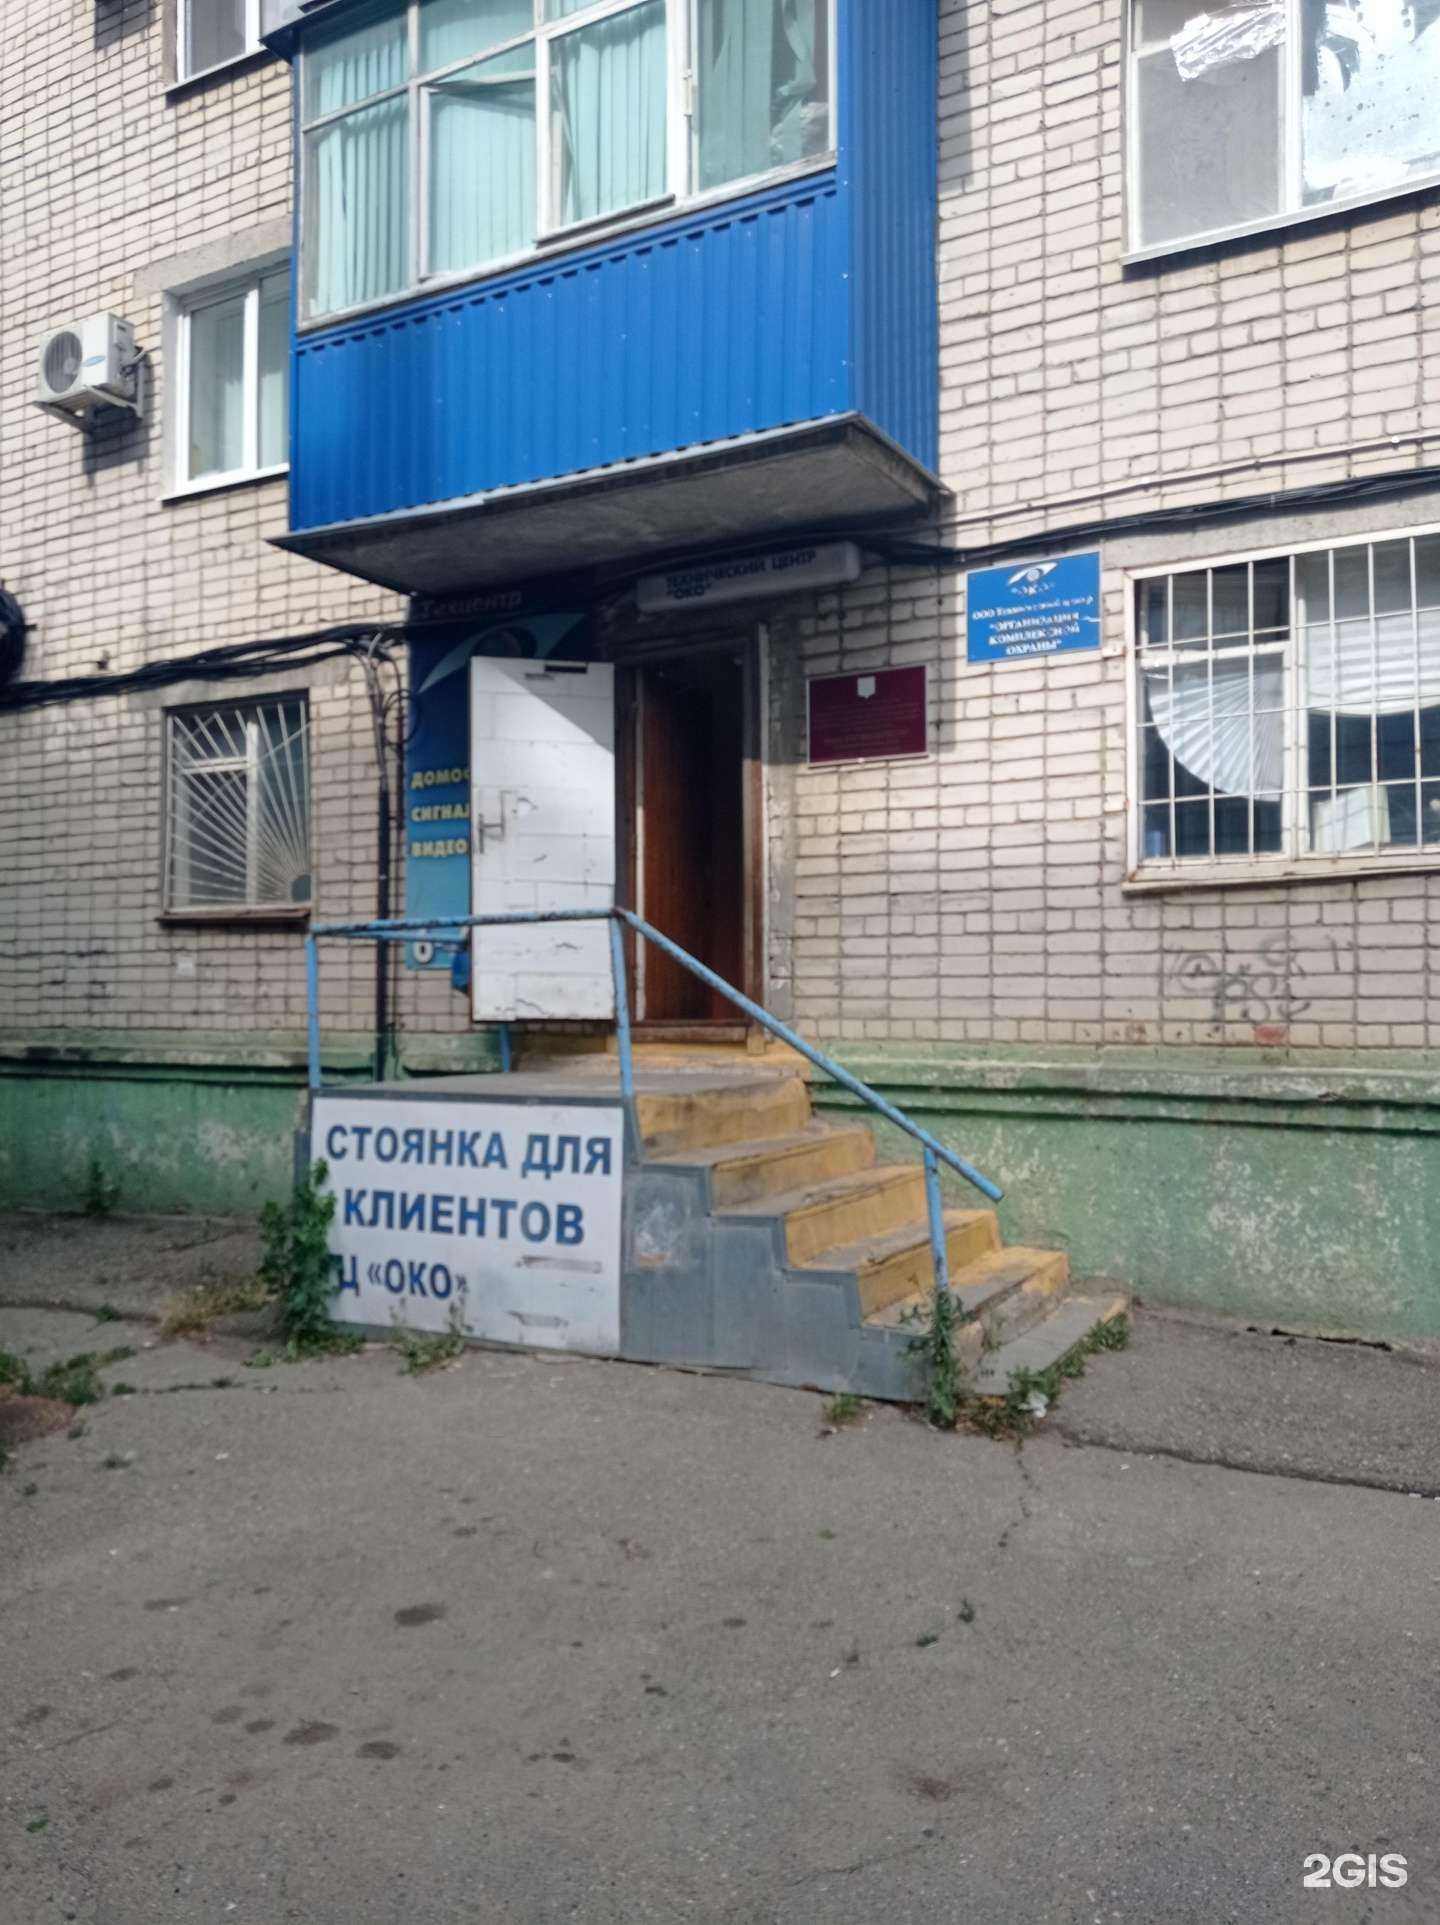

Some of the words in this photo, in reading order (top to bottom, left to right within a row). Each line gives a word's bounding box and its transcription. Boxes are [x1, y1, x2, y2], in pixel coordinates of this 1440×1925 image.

[772, 550, 816, 570] ЦЕНТР
[411, 838, 468, 858] ВИДЕО
[326, 1124, 508, 1169] СТОЯНКА
[521, 1132, 612, 1180] ДЛЯ
[343, 1187, 585, 1246] КЛИЕНТОВ
[367, 1258, 469, 1300] «ОКО»
